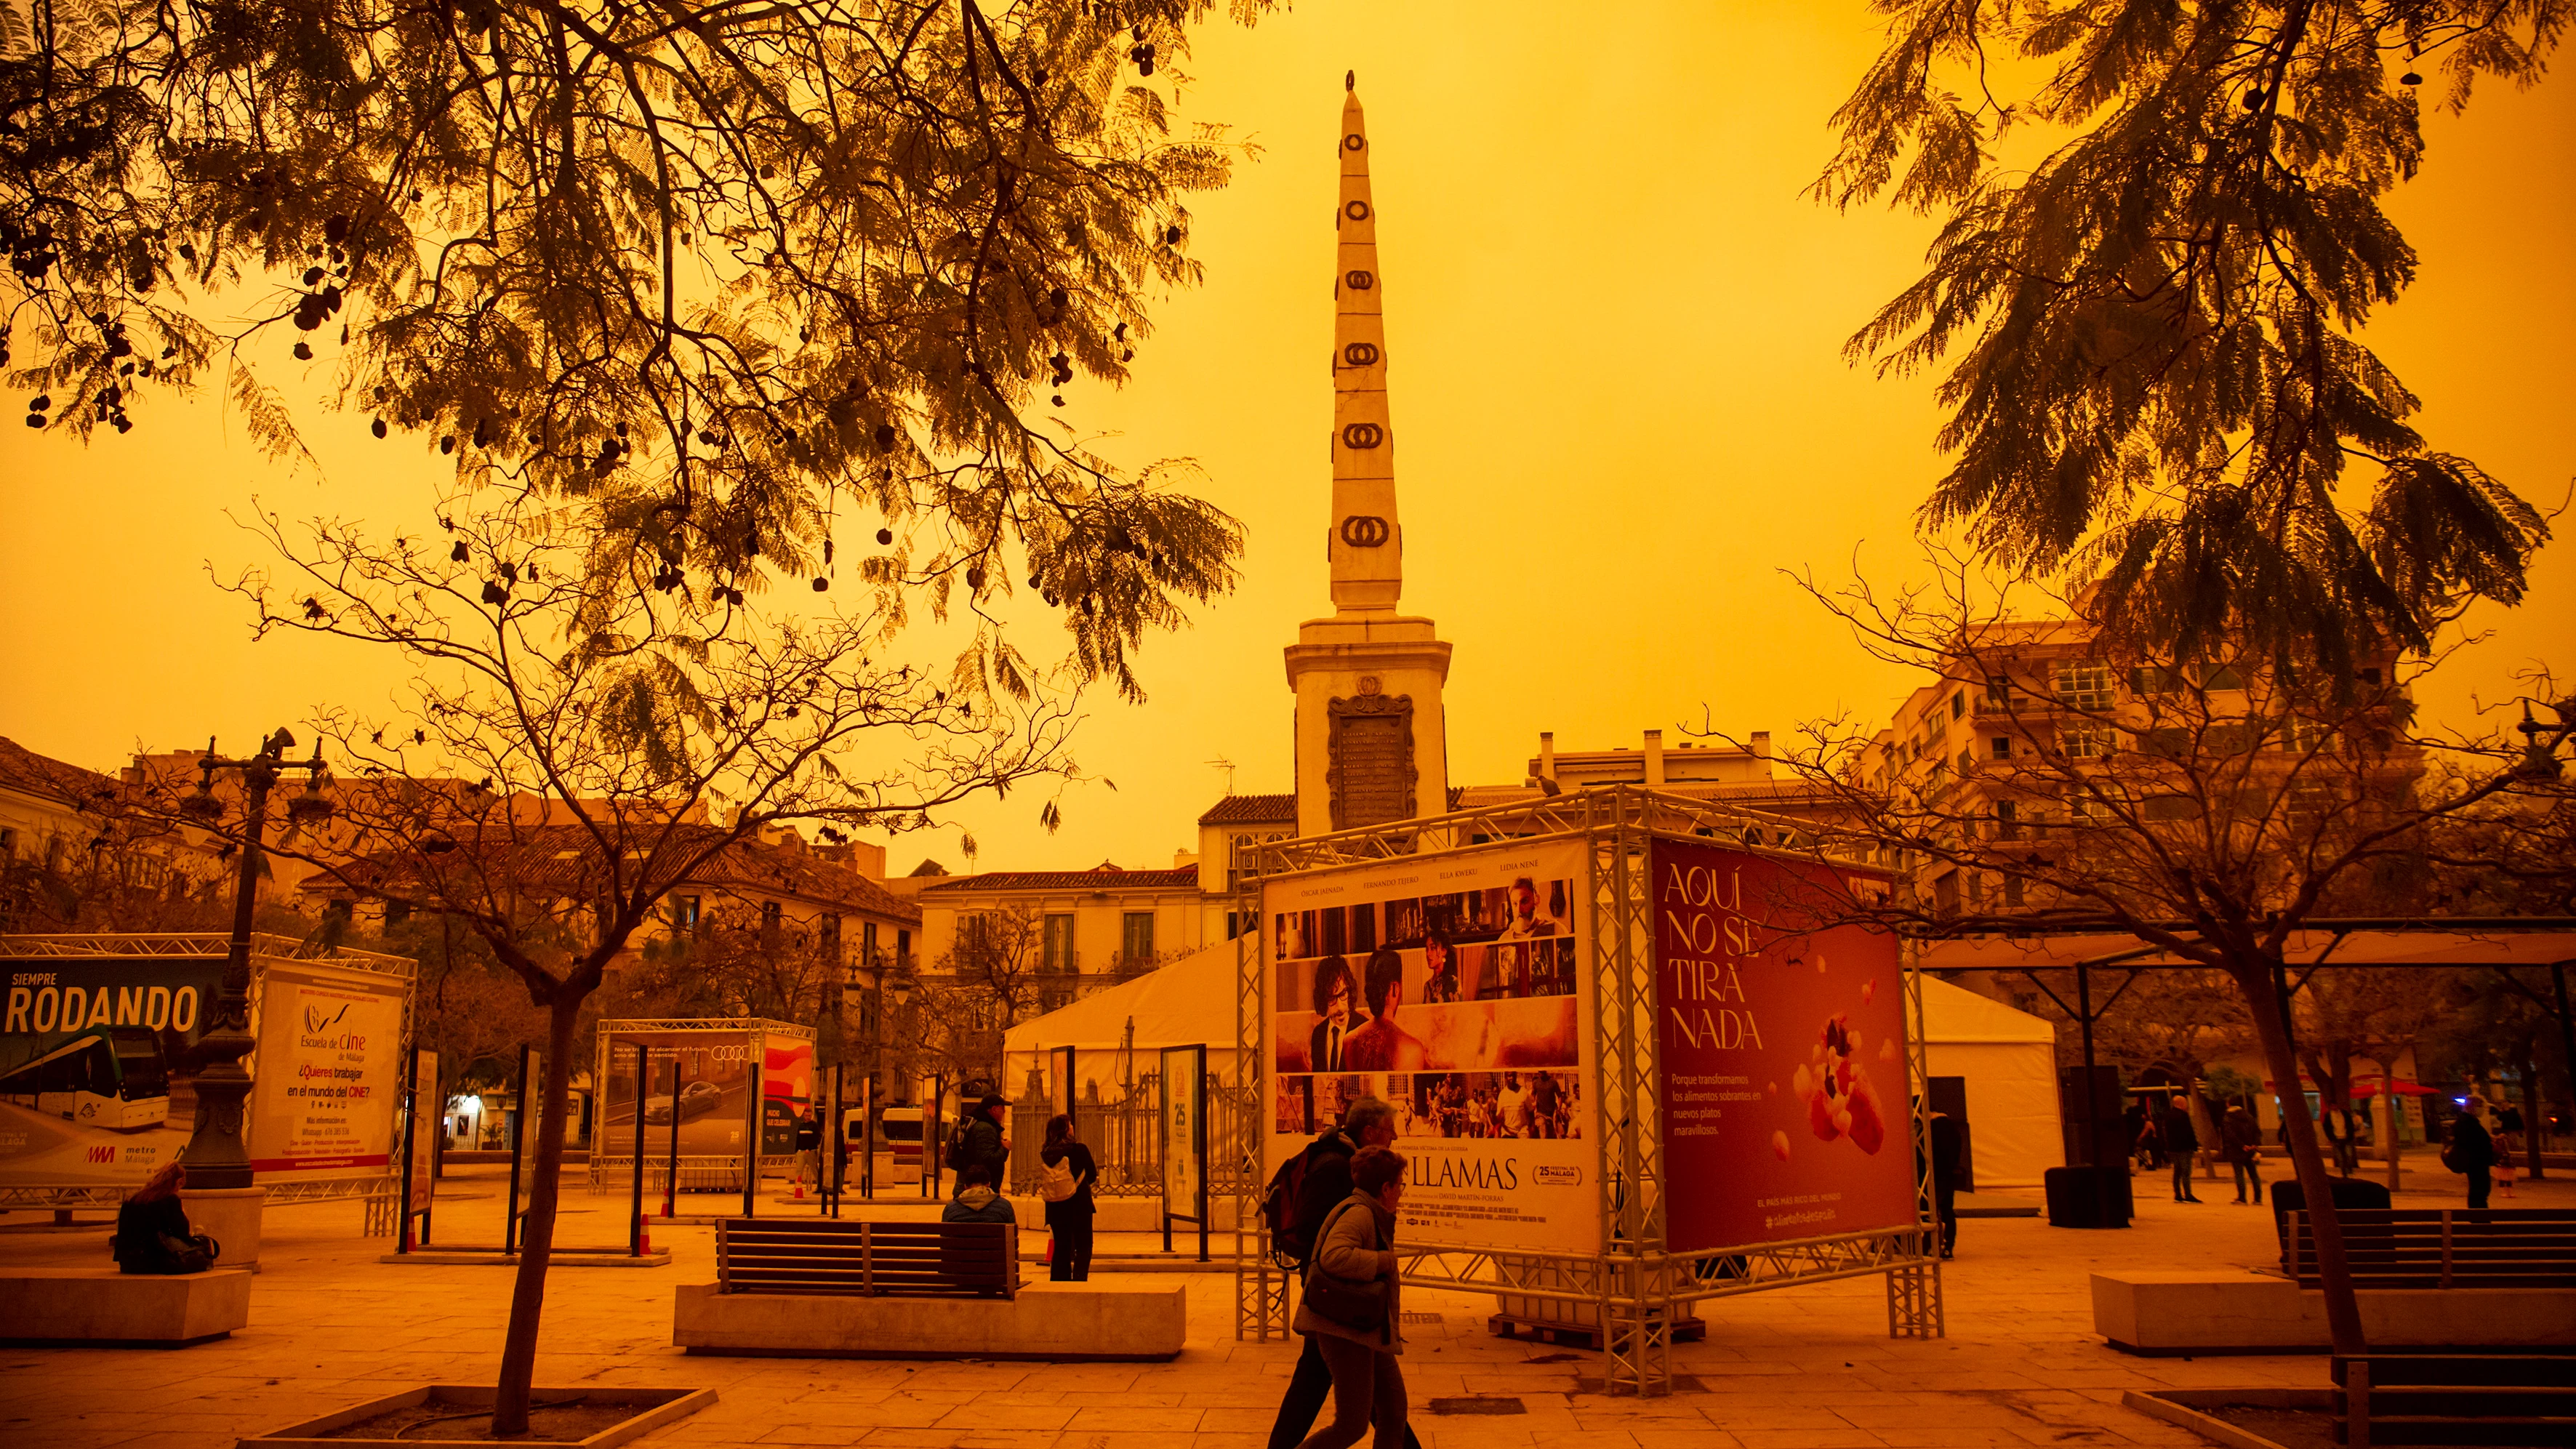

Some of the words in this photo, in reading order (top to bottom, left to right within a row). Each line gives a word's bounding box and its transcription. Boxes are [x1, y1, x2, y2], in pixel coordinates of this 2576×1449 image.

[1439, 871, 1454, 880] ELLA
[1455, 867, 1478, 878] KWEKU
[1500, 863, 1518, 872] LIDIA
[1363, 878, 1396, 889] FERNANDO
[1397, 875, 1419, 886] TEJERO
[1664, 863, 1743, 912] AQUÍ
[1301, 888, 1318, 898] ÓSCAR
[1320, 886, 1344, 896] JAENADA
[1666, 910, 1717, 954] NO
[1724, 916, 1762, 958] SE
[12, 973, 57, 985] SIEMPRE
[1668, 958, 1745, 1003] TIRA
[5, 985, 198, 1032] RODANDO
[1670, 1007, 1763, 1050] NADA
[301, 1035, 327, 1048] Escuela
[329, 1038, 337, 1049] de
[338, 1052, 345, 1061] de
[346, 1052, 365, 1063] Málaga
[299, 1064, 332, 1080] ¿Quieres
[334, 1067, 364, 1082] trabajar
[1672, 1073, 1697, 1087] Porque
[1698, 1072, 1749, 1085] transformamos
[288, 1087, 298, 1096] en
[300, 1085, 307, 1096] el
[308, 1085, 334, 1097] mundo
[336, 1086, 347, 1098] del
[349, 1086, 370, 1098] CINE?
[1672, 1090, 1683, 1101] los
[1684, 1090, 1719, 1101] alimentos
[1720, 1090, 1752, 1101] sobrantes
[1174, 1102, 1186, 1125] 25
[1674, 1109, 1698, 1119] nuevos
[1700, 1107, 1722, 1120] platos
[1674, 1124, 1719, 1136] maravillosos.
[125, 1155, 155, 1165] Málaga
[1412, 1156, 1517, 1190] LLAMAS
[1539, 1165, 1549, 1176] 25
[1757, 1199, 1765, 1208] EL
[1809, 1194, 1821, 1203] DEL
